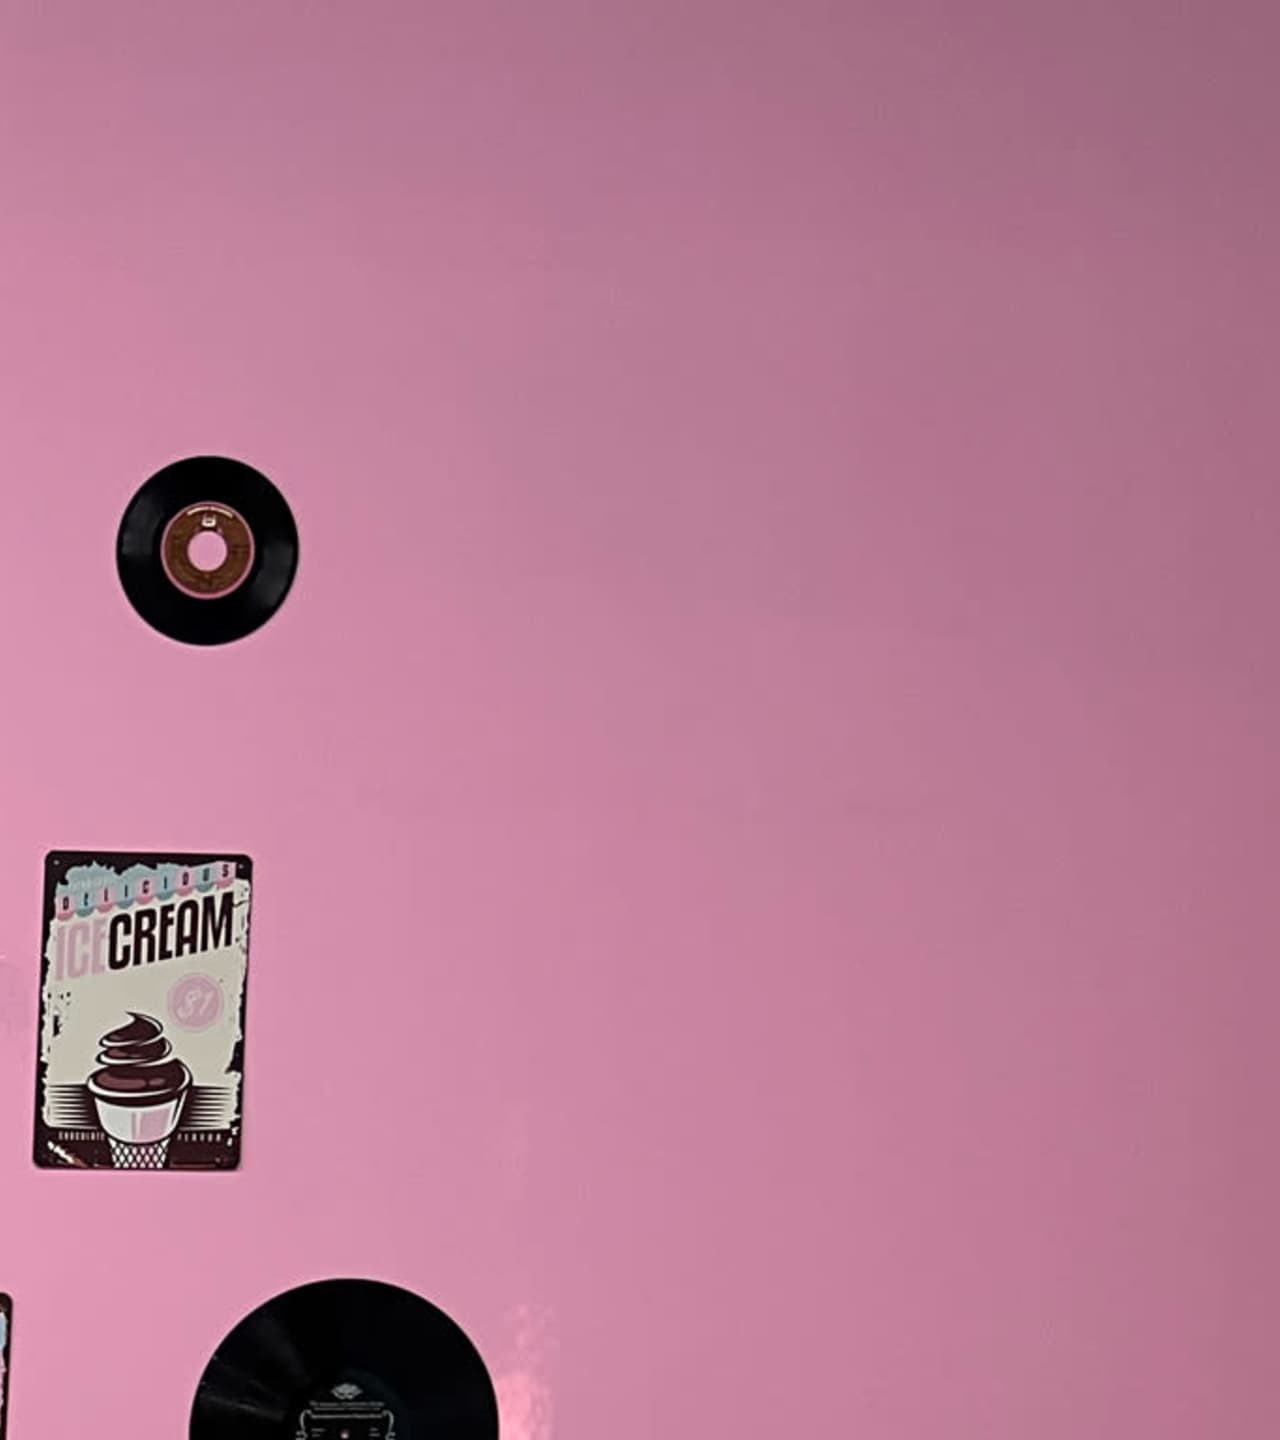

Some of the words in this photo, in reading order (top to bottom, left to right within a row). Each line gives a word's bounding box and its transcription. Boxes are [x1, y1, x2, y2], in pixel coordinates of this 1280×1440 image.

[62, 863, 230, 911] DELICIOUS
[55, 917, 109, 982] ICE
[108, 891, 234, 970] CREAM
